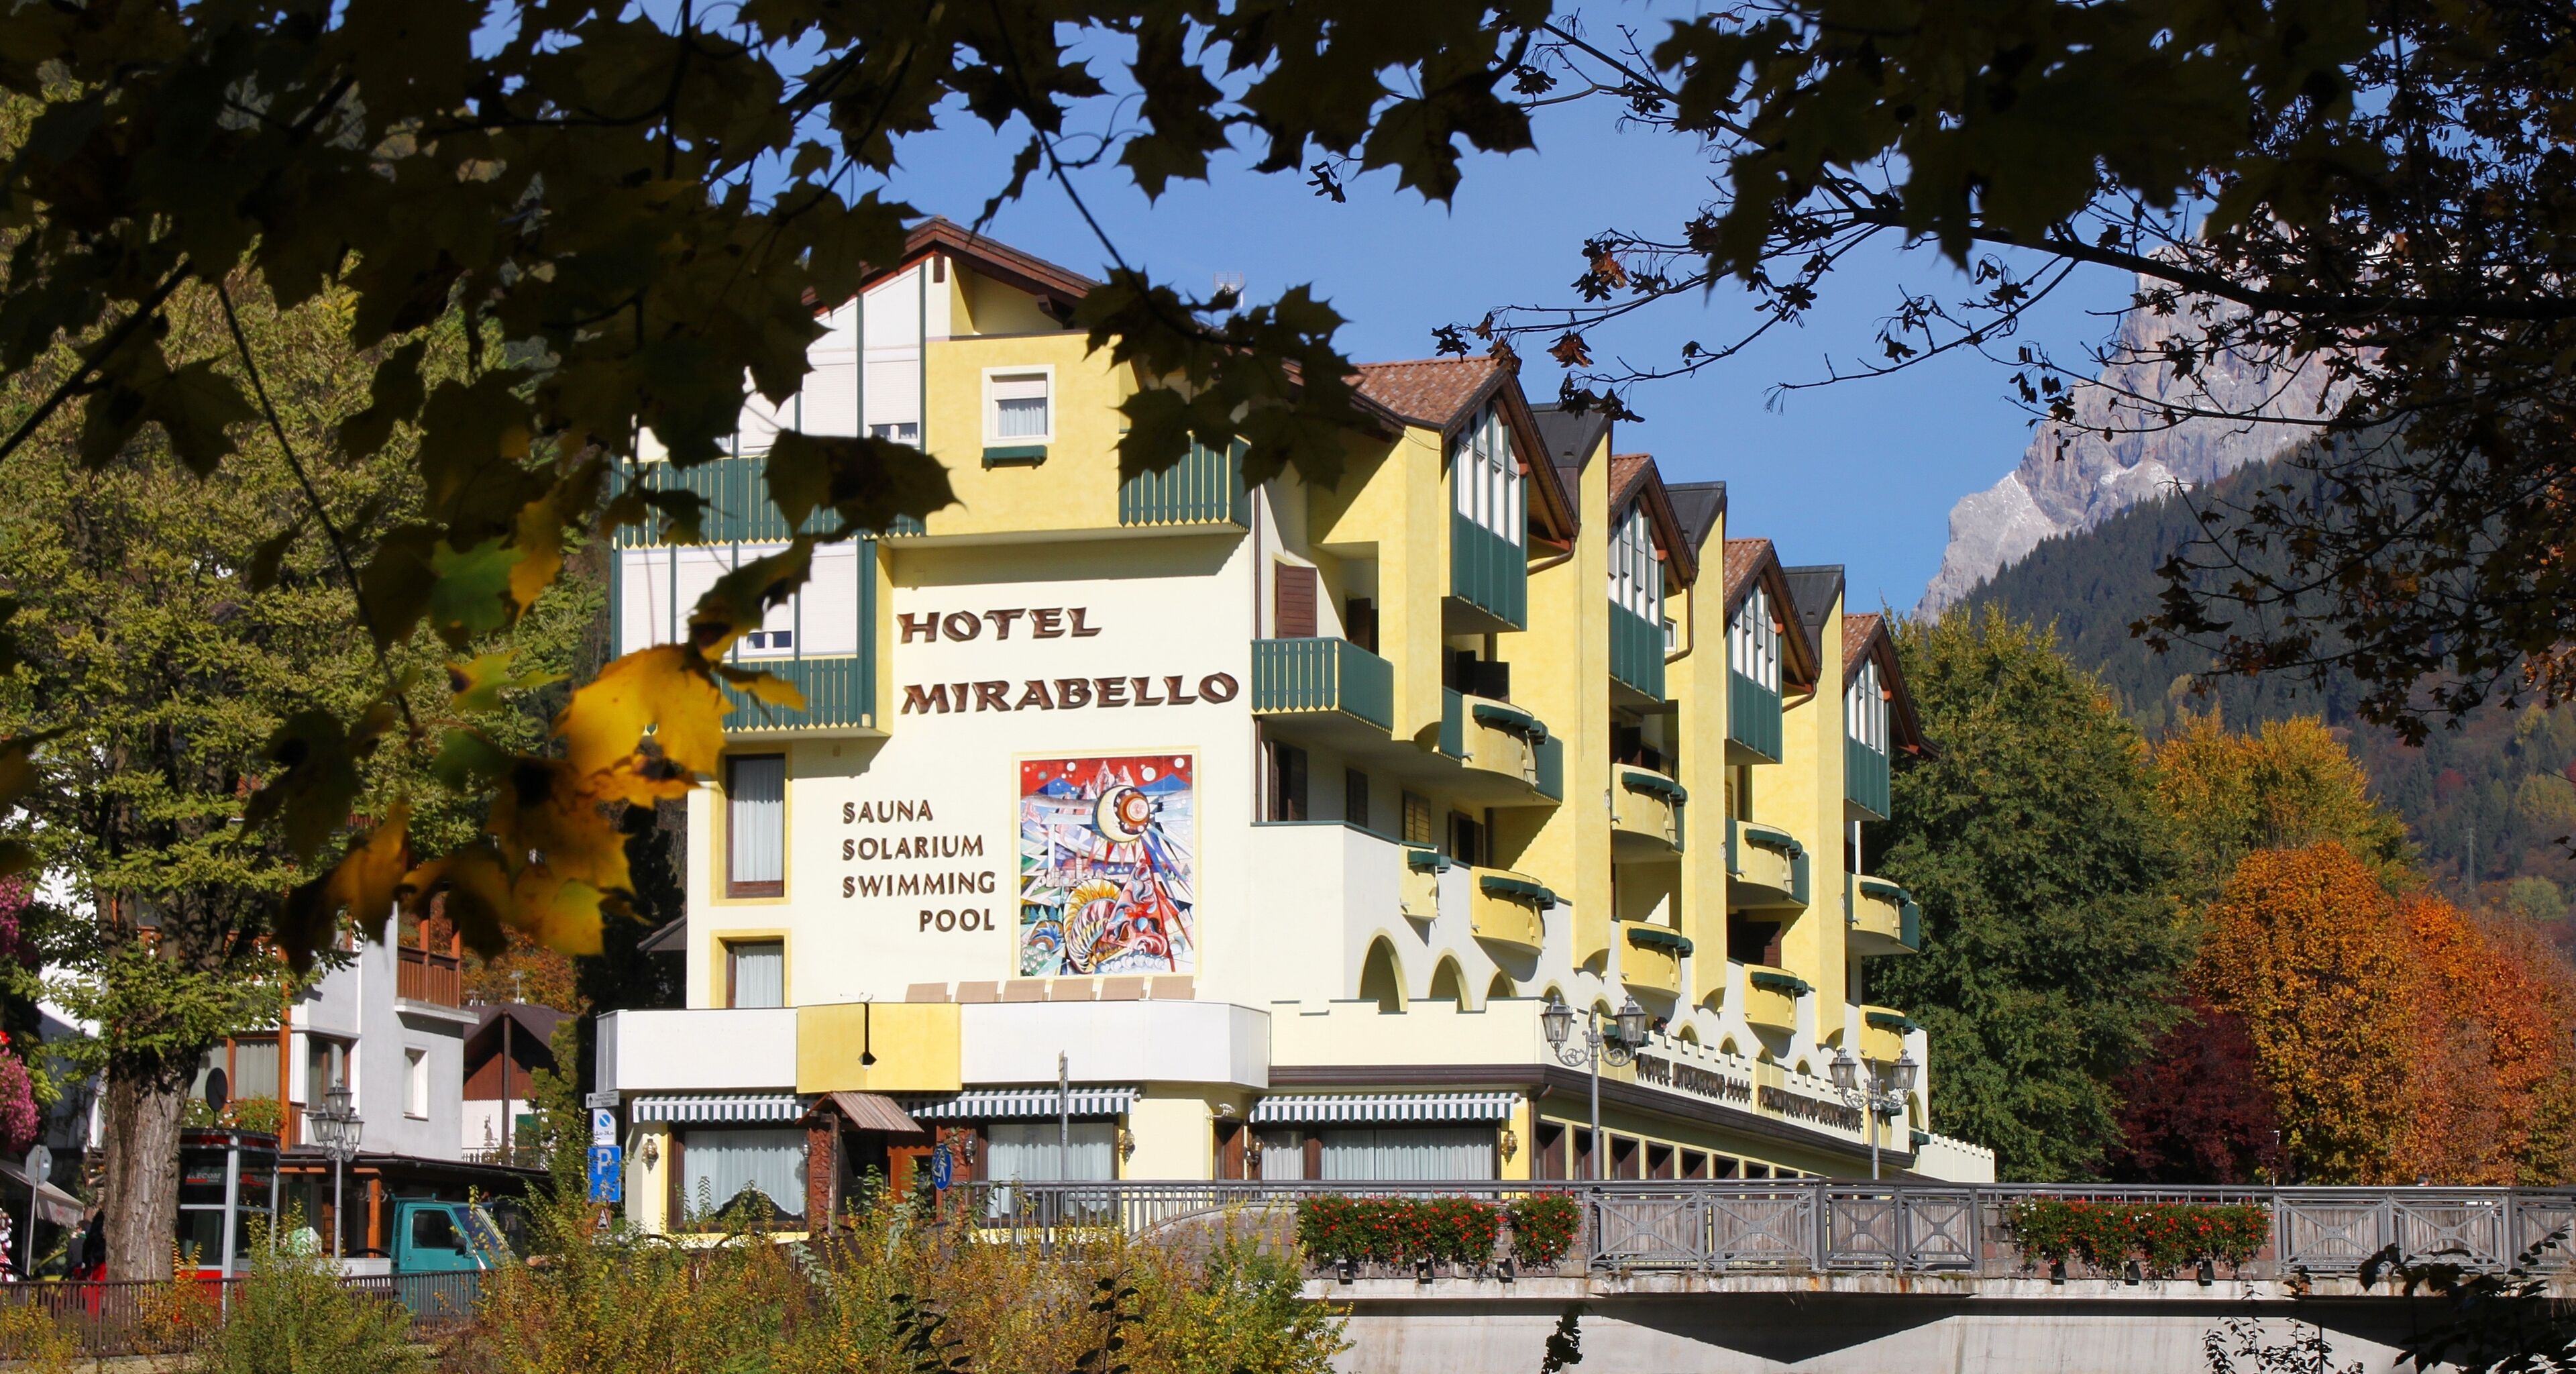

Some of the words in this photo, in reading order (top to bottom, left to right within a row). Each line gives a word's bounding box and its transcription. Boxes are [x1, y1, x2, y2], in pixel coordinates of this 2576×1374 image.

[896, 606, 1102, 645] HOTEL
[900, 671, 1240, 715] MIRABELLO
[843, 799, 934, 825] SAUNA
[843, 834, 984, 861] SOLARIUM
[843, 870, 996, 898] SWIMMING
[919, 908, 996, 933] POOL
[597, 1148, 612, 1175] P
